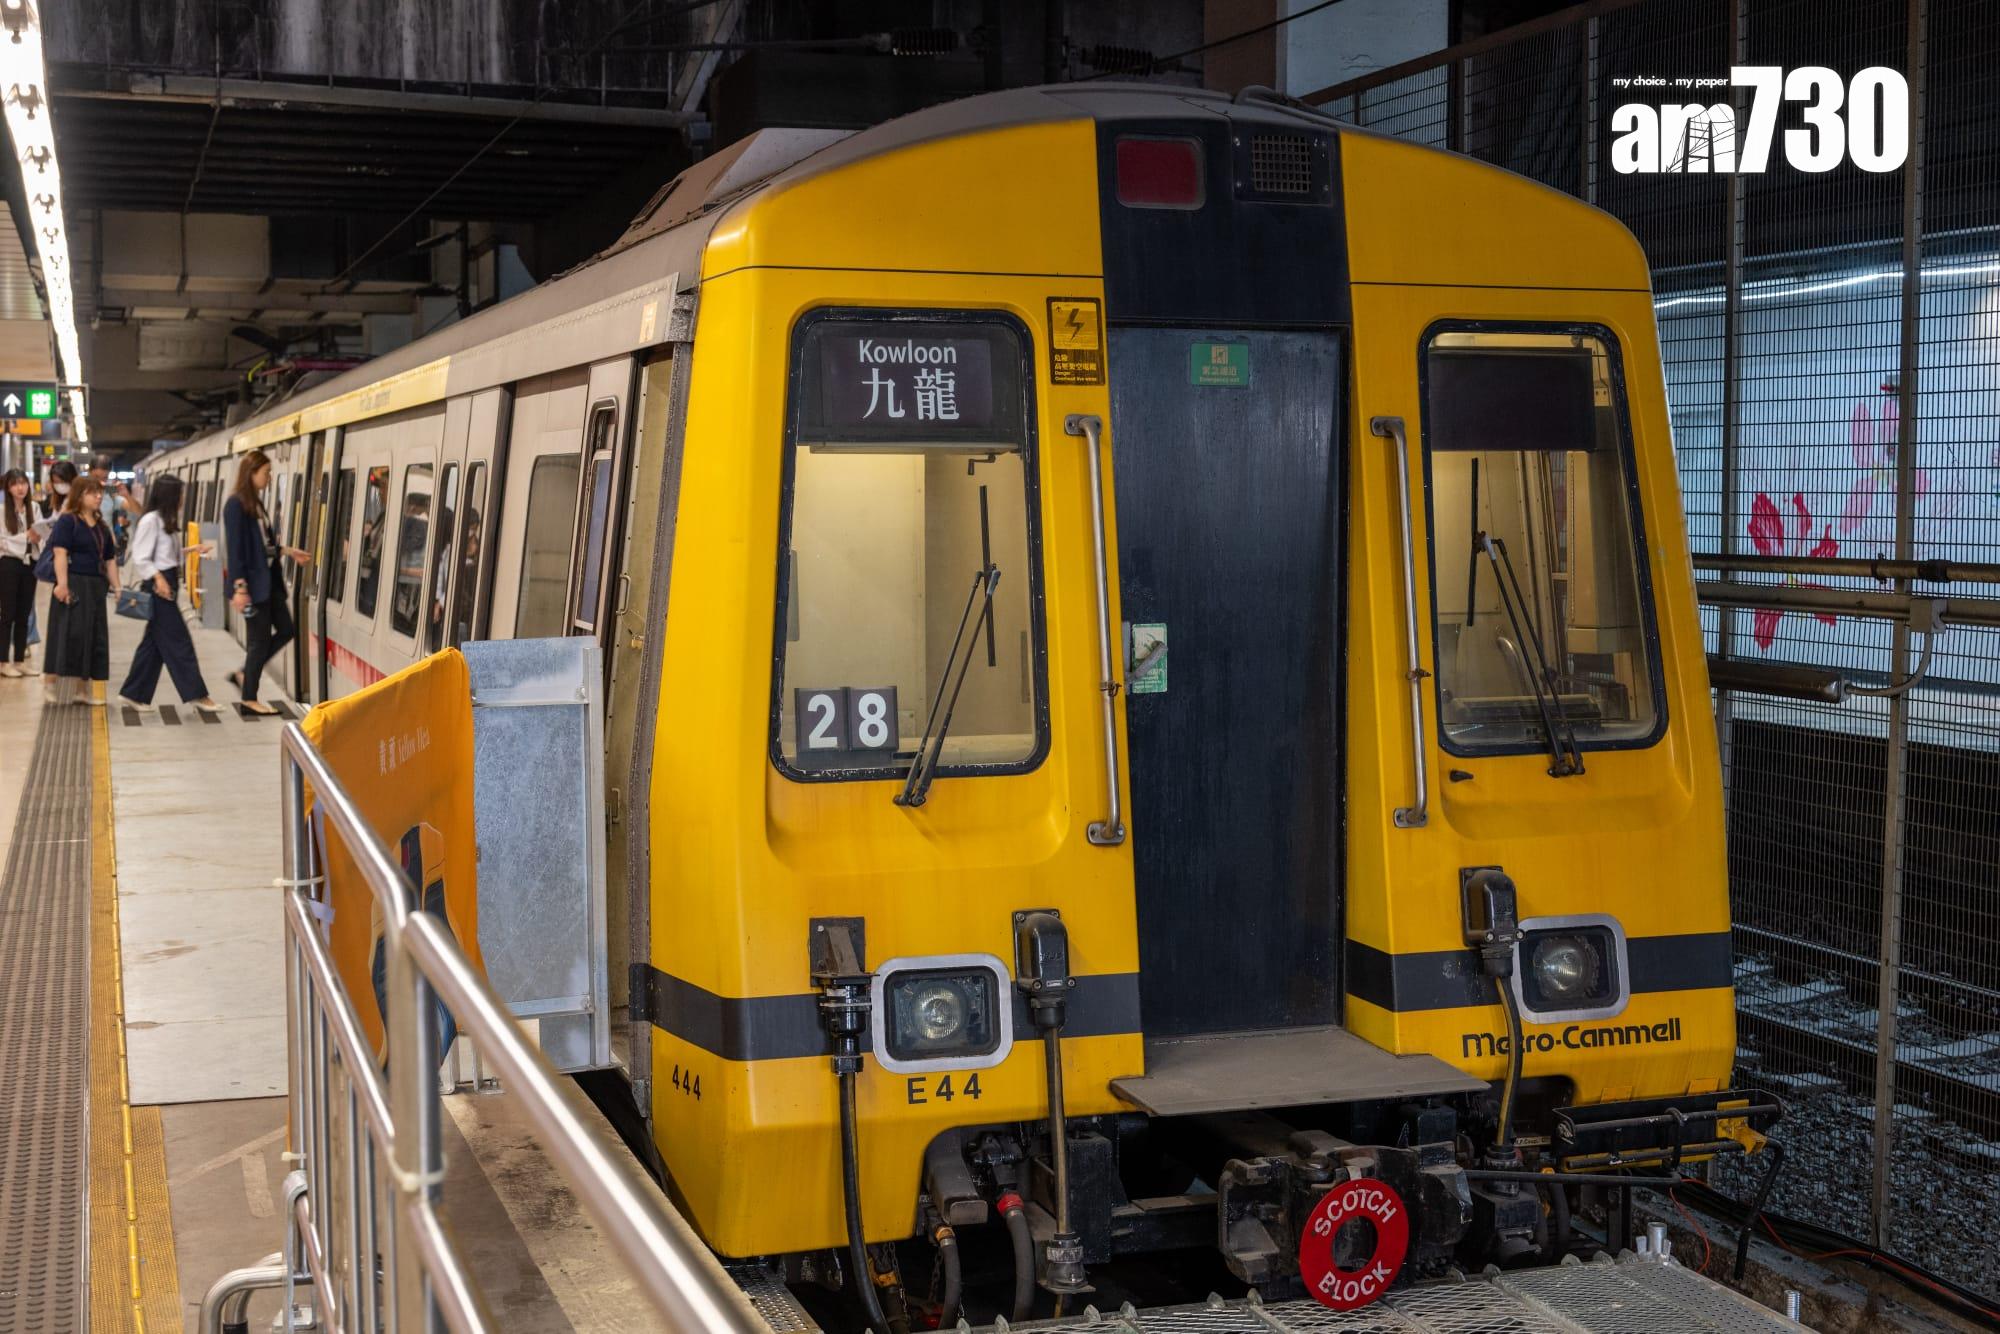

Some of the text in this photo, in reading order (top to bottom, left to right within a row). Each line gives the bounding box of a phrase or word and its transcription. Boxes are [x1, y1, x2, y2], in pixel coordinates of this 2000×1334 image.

[858, 339, 957, 364] Kowloon
[861, 367, 960, 420] 九龍
[1462, 1017, 1682, 1058] Mero-Cammell
[672, 1064, 701, 1101] 444
[907, 1072, 982, 1105] E44
[1314, 1188, 1397, 1237] SCOTCH
[1318, 1260, 1392, 1301] BLOCK
